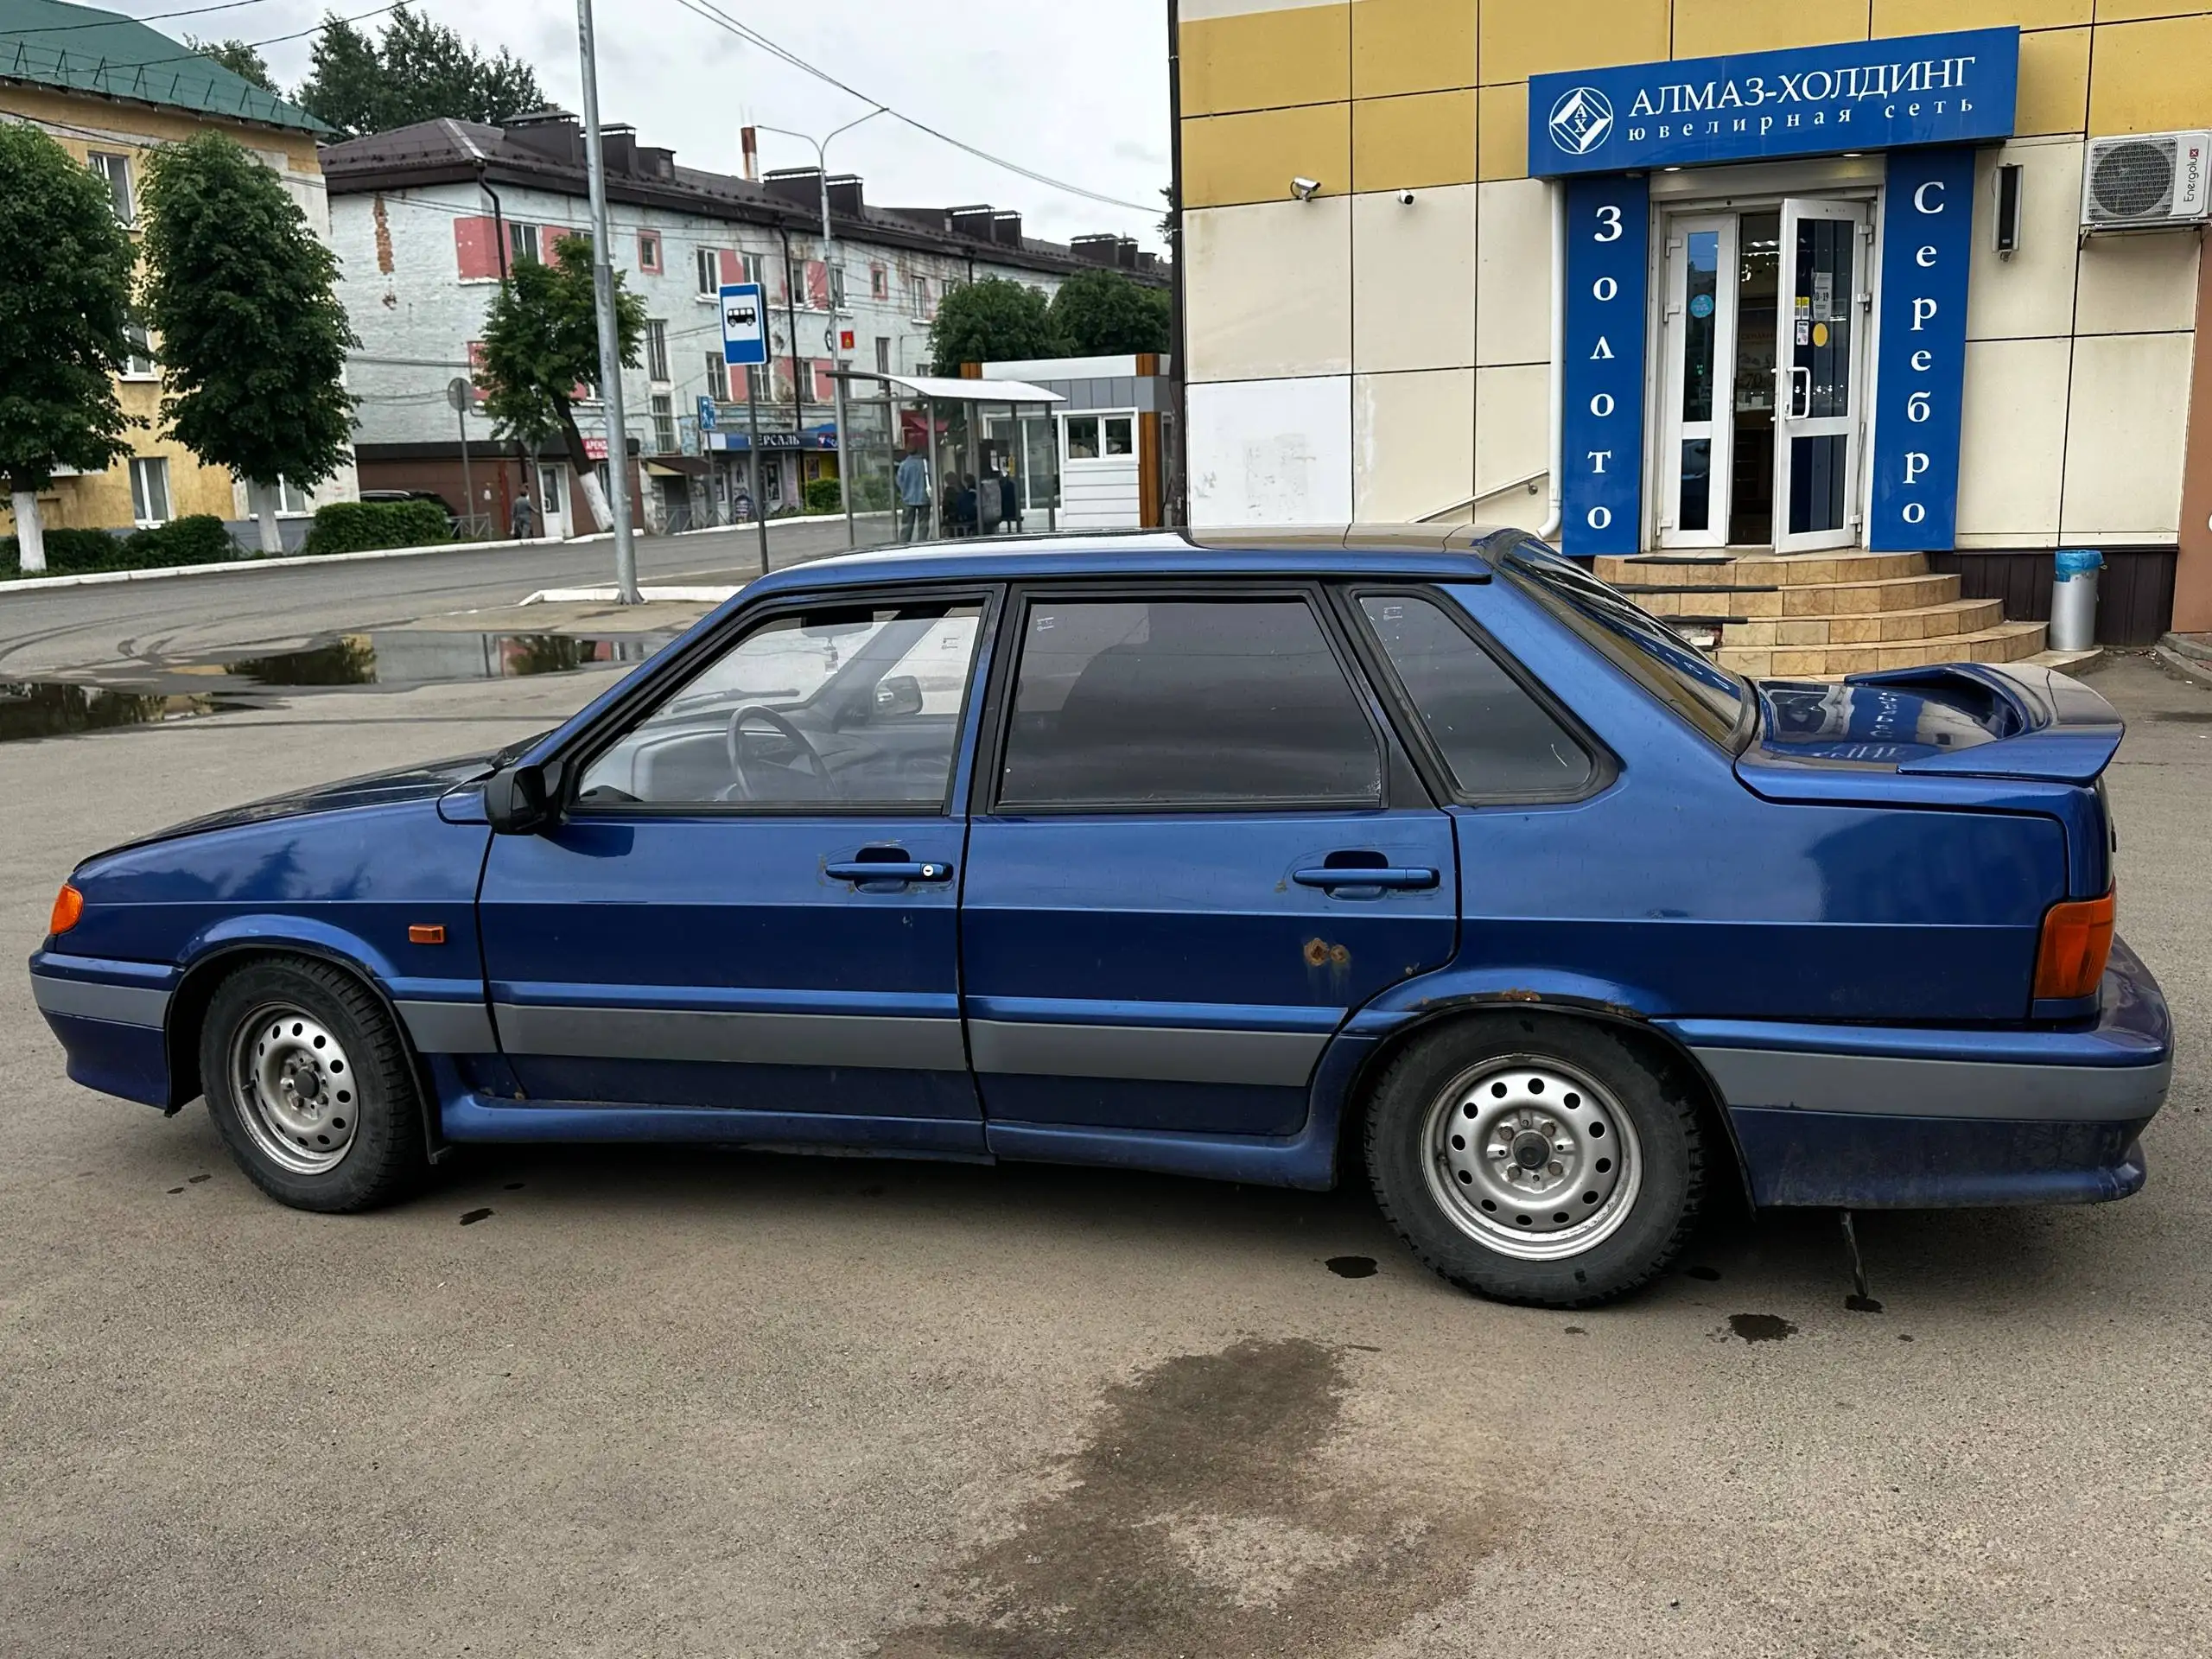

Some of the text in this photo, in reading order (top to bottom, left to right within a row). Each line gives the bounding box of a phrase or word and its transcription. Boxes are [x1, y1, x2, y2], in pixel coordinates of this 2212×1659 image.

[1627, 55, 1976, 118] АЛМАЗ-ХОЛДИНГ
[1627, 97, 1974, 142] ювелирная сеть
[2183, 148, 2200, 203] Energolux
[1586, 205, 1624, 530] Золото
[1902, 181, 1945, 524] Серебро
